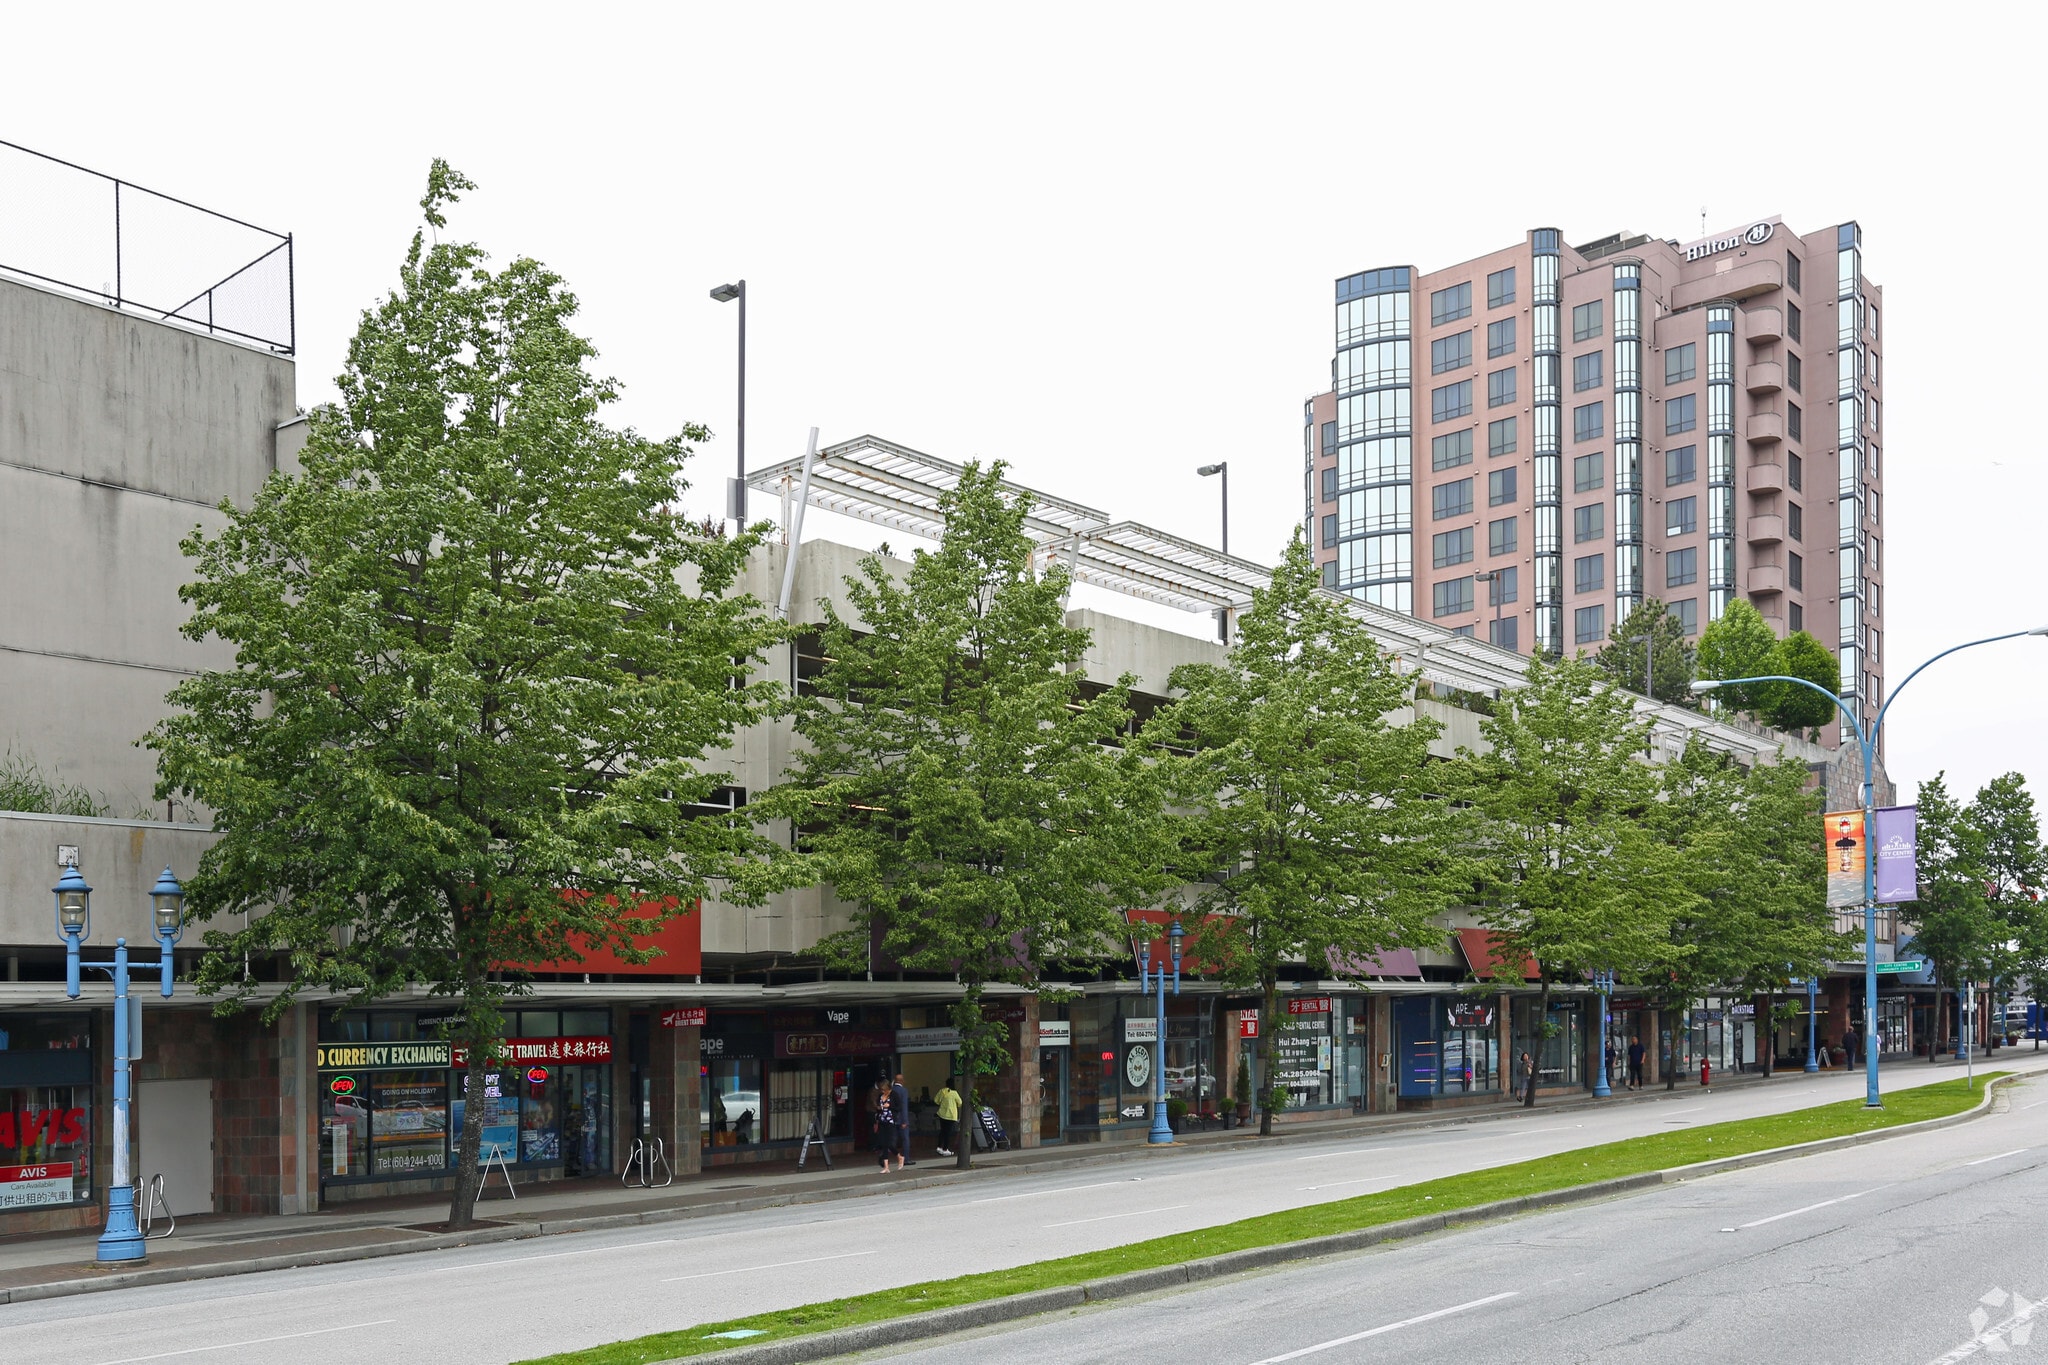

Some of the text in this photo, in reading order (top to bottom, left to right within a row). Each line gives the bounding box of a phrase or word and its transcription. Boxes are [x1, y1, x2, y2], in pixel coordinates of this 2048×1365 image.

[1686, 235, 1740, 262] Hilton
[1291, 1001, 1300, 1012] 牙
[1456, 1003, 1468, 1014] APE
[1732, 1004, 1755, 1014] BACKSTAGE
[827, 1010, 849, 1023] Vape
[1241, 1009, 1257, 1018] NTAL
[675, 1017, 704, 1027] ORIENT TRAVEL
[1312, 1020, 1326, 1029] CENTRE
[700, 1038, 724, 1055] ape
[1279, 1038, 1290, 1047] Hui
[1291, 1037, 1310, 1047] Zhang
[328, 1047, 388, 1066] CURRENCY
[391, 1045, 448, 1064] EXCHANGE
[516, 1044, 548, 1059] TRAVEL
[549, 1041, 610, 1059] 遠東旅行社
[1135, 1047, 1148, 1061] SCOTT
[1102, 1052, 1114, 1060] OPEN
[530, 1069, 548, 1080] OPEN
[332, 1081, 353, 1092] OPEN
[410, 1087, 437, 1095] HOLIDAY?
[0, 1107, 85, 1149] AVIS
[20, 1167, 47, 1178] AVIS
[10, 1180, 56, 1191] Cars Available!
